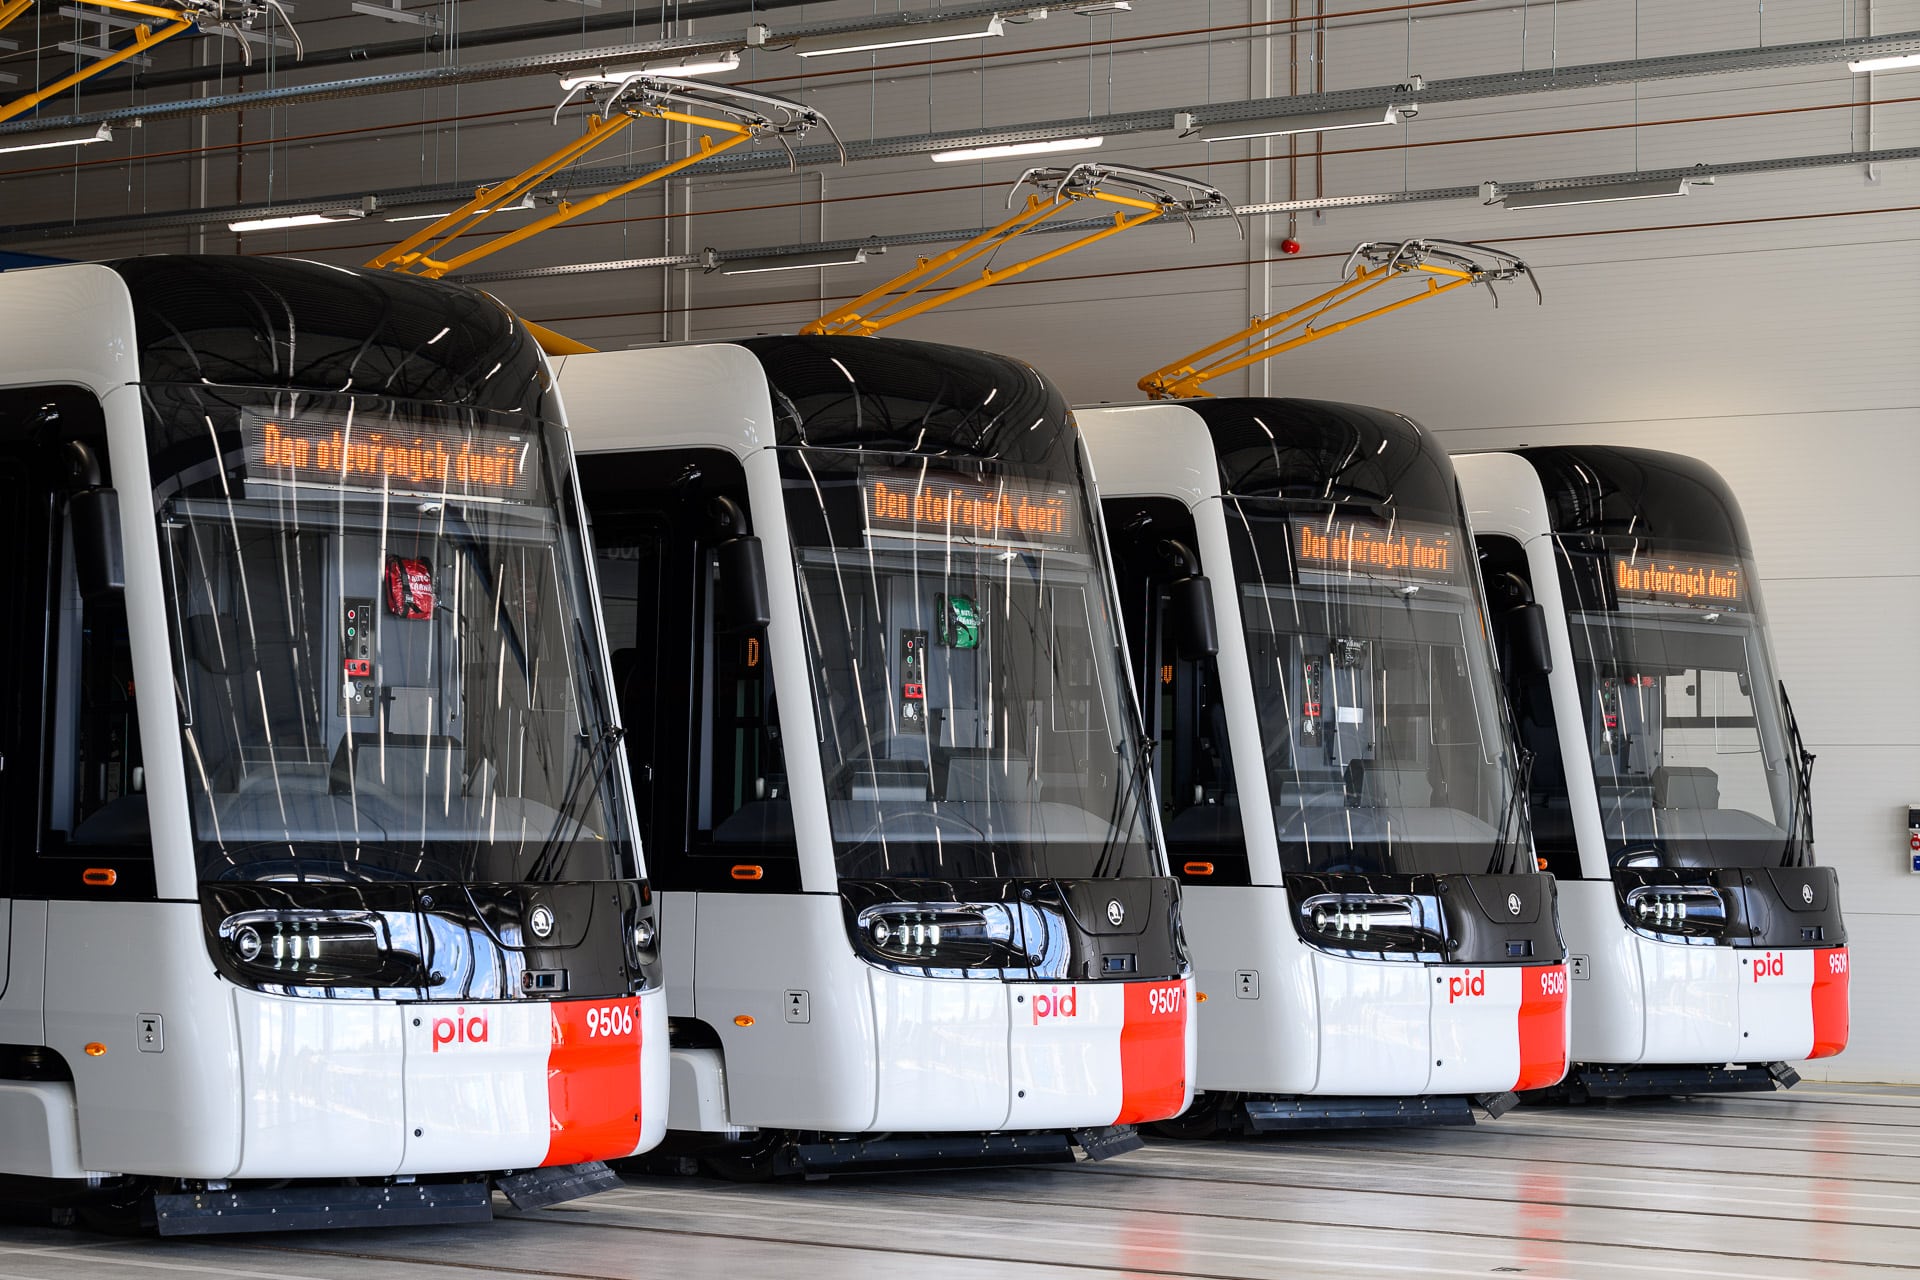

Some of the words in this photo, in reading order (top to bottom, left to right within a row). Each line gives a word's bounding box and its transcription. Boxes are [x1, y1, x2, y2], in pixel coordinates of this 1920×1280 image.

[264, 423, 309, 468] Den
[317, 430, 448, 482] otevřených
[456, 442, 516, 486] dveří
[875, 481, 908, 519] Den
[915, 486, 1013, 531] otevřených
[1018, 497, 1062, 533] dveří
[1302, 526, 1328, 559] Den
[1332, 530, 1408, 569] otevřených
[1413, 538, 1448, 570] dveří
[1618, 560, 1640, 590] Den
[1643, 563, 1705, 598] otevřených
[1708, 569, 1737, 598] dveří
[748, 637, 759, 667] D
[1753, 951, 1784, 983] pid
[1829, 953, 1847, 974] 9509
[1149, 987, 1181, 1014] 9507
[1449, 968, 1485, 1004] pid
[1541, 972, 1564, 995] 9508
[586, 1006, 633, 1038] 9506
[1033, 986, 1077, 1026] pid
[432, 1006, 488, 1053] pid
